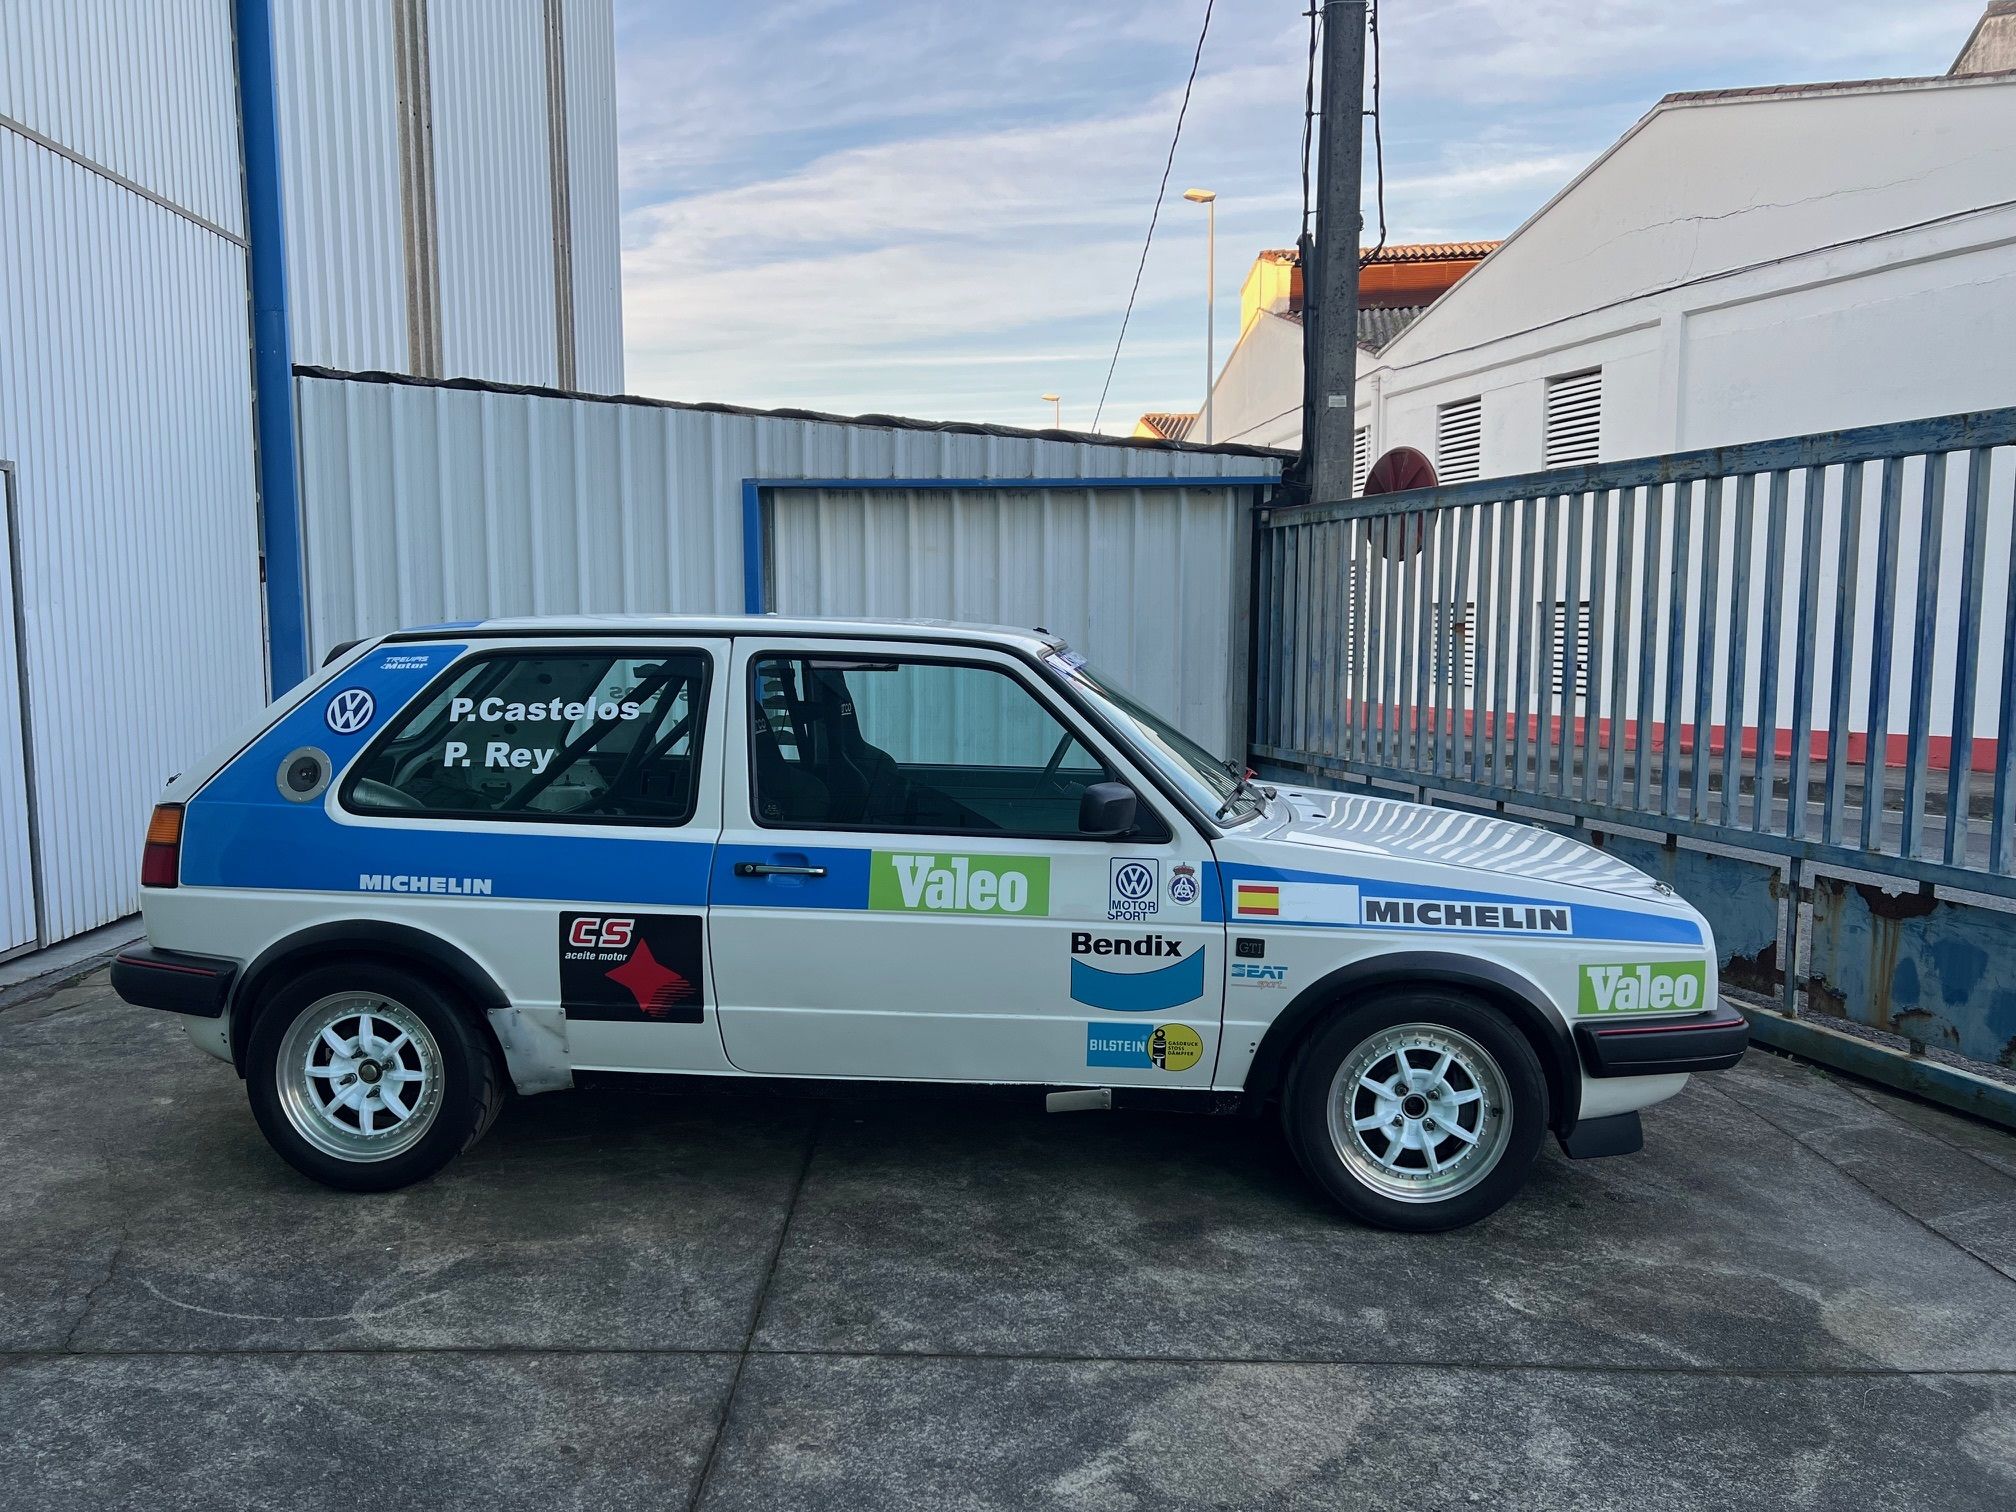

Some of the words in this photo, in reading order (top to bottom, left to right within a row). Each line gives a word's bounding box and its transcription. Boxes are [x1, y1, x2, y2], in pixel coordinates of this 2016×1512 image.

[384, 662, 428, 670] Motor
[449, 697, 640, 722] P.Castelos
[443, 741, 471, 767] P.
[484, 741, 555, 775] Rey
[359, 874, 492, 895] MICHELIN
[891, 854, 1028, 912] Valeo
[1111, 900, 1156, 912] MOTOR
[1366, 900, 1568, 931] MICHELIN
[1107, 911, 1148, 921] SPORT
[568, 917, 636, 948] CS
[1071, 932, 1182, 957] Bendix
[1239, 942, 1263, 955] GTI
[565, 951, 597, 960] aceite
[598, 952, 628, 961] motor
[1231, 963, 1288, 980] SEAT
[1256, 979, 1283, 990] sport
[1586, 965, 1698, 1011] Valeo
[1089, 1039, 1147, 1053] BILSTEIN
